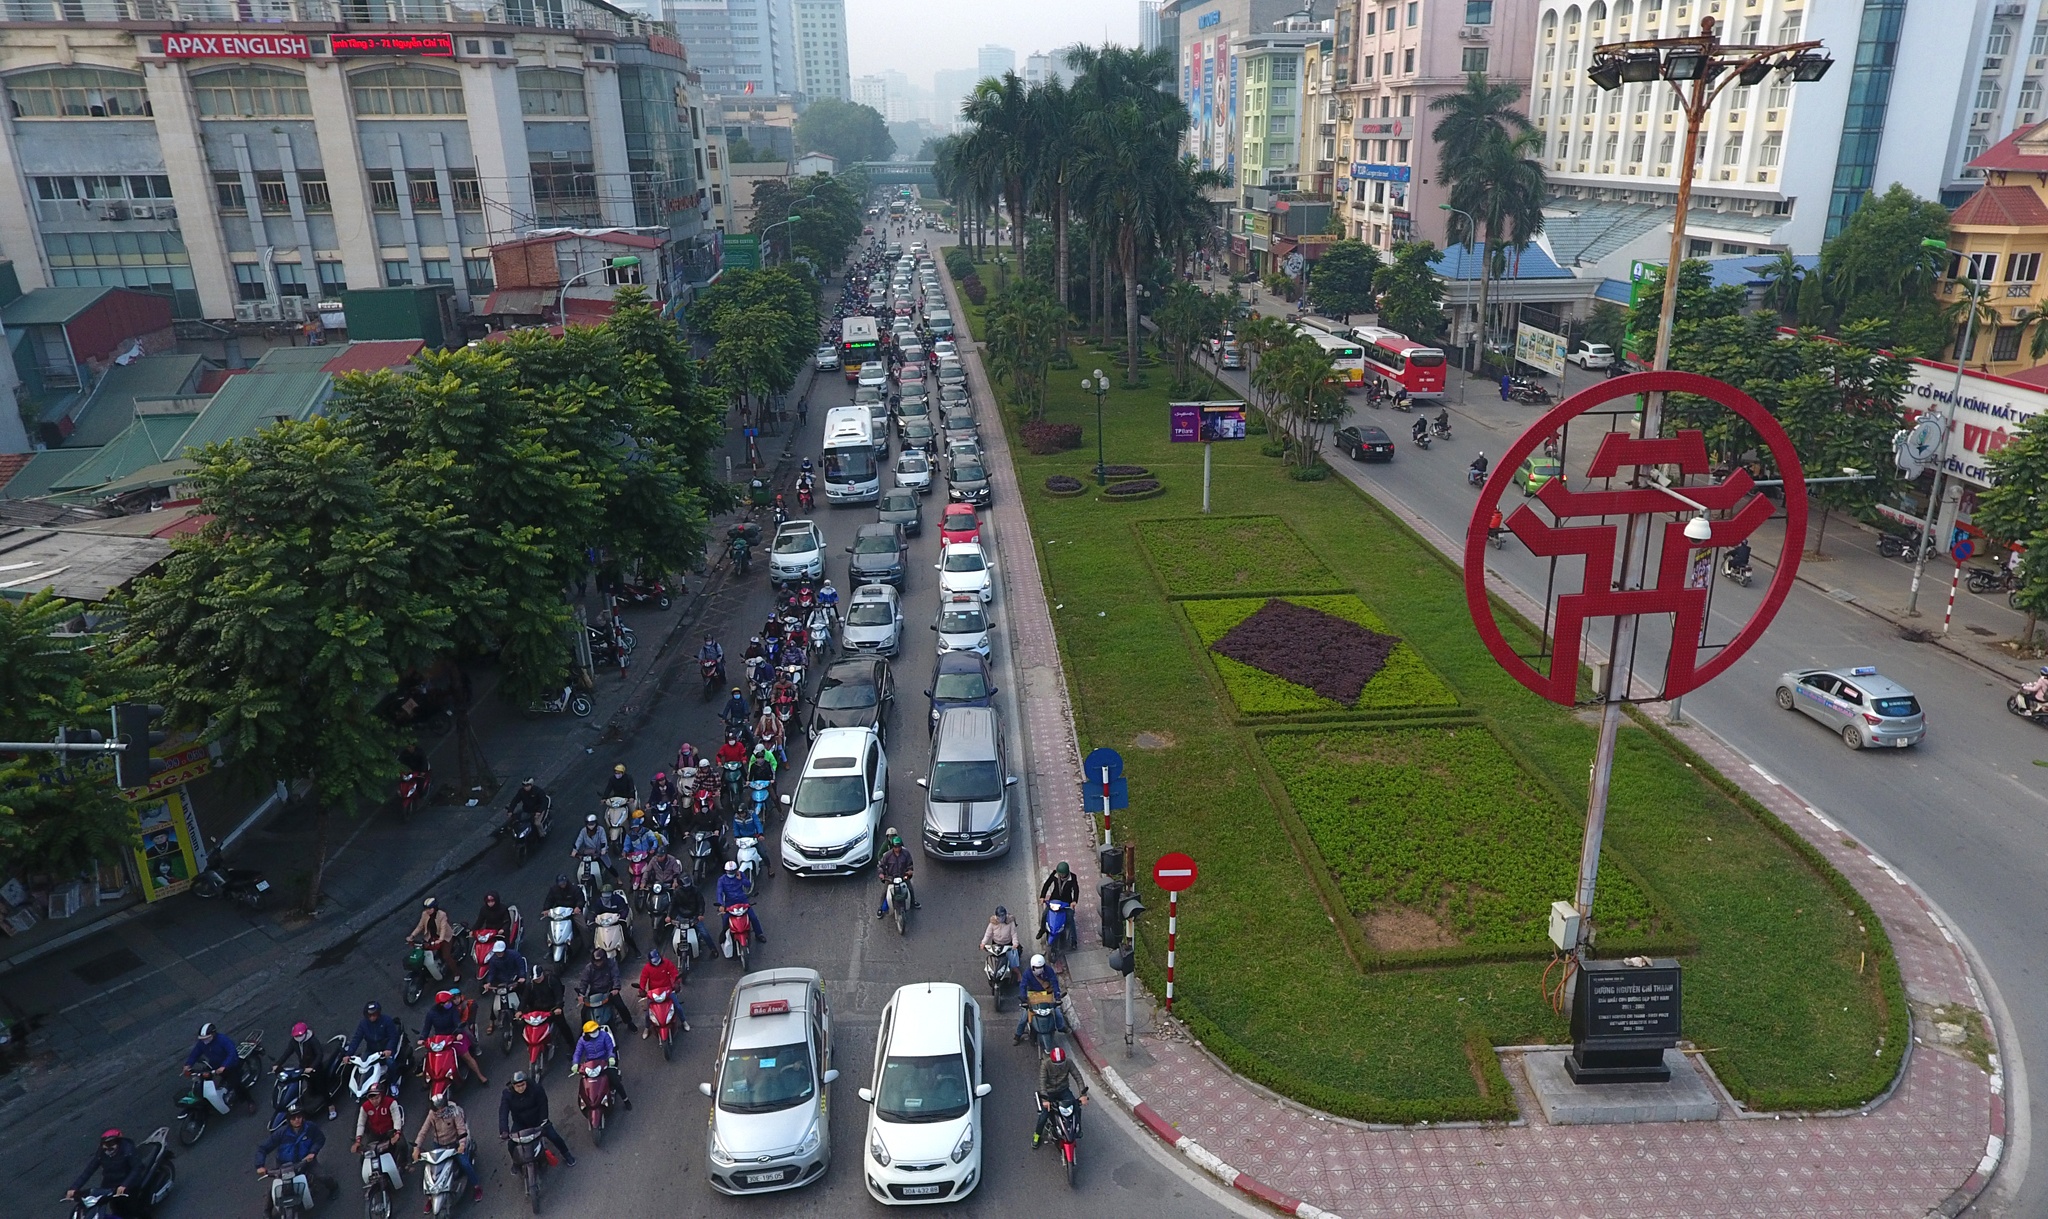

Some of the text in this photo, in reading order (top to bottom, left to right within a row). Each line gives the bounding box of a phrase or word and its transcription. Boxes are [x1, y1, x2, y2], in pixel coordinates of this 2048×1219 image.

[167, 37, 307, 55] APAX ENGLISH
[369, 39, 375, 48] 3
[381, 39, 392, 48] 71
[393, 36, 422, 50] Nguyễn
[423, 38, 437, 48] Chí
[1917, 382, 1934, 398] CỔ
[1962, 396, 1989, 415] KÍNH
[185, 811, 200, 852] Vietnam
[1653, 984, 1674, 992] THANH
